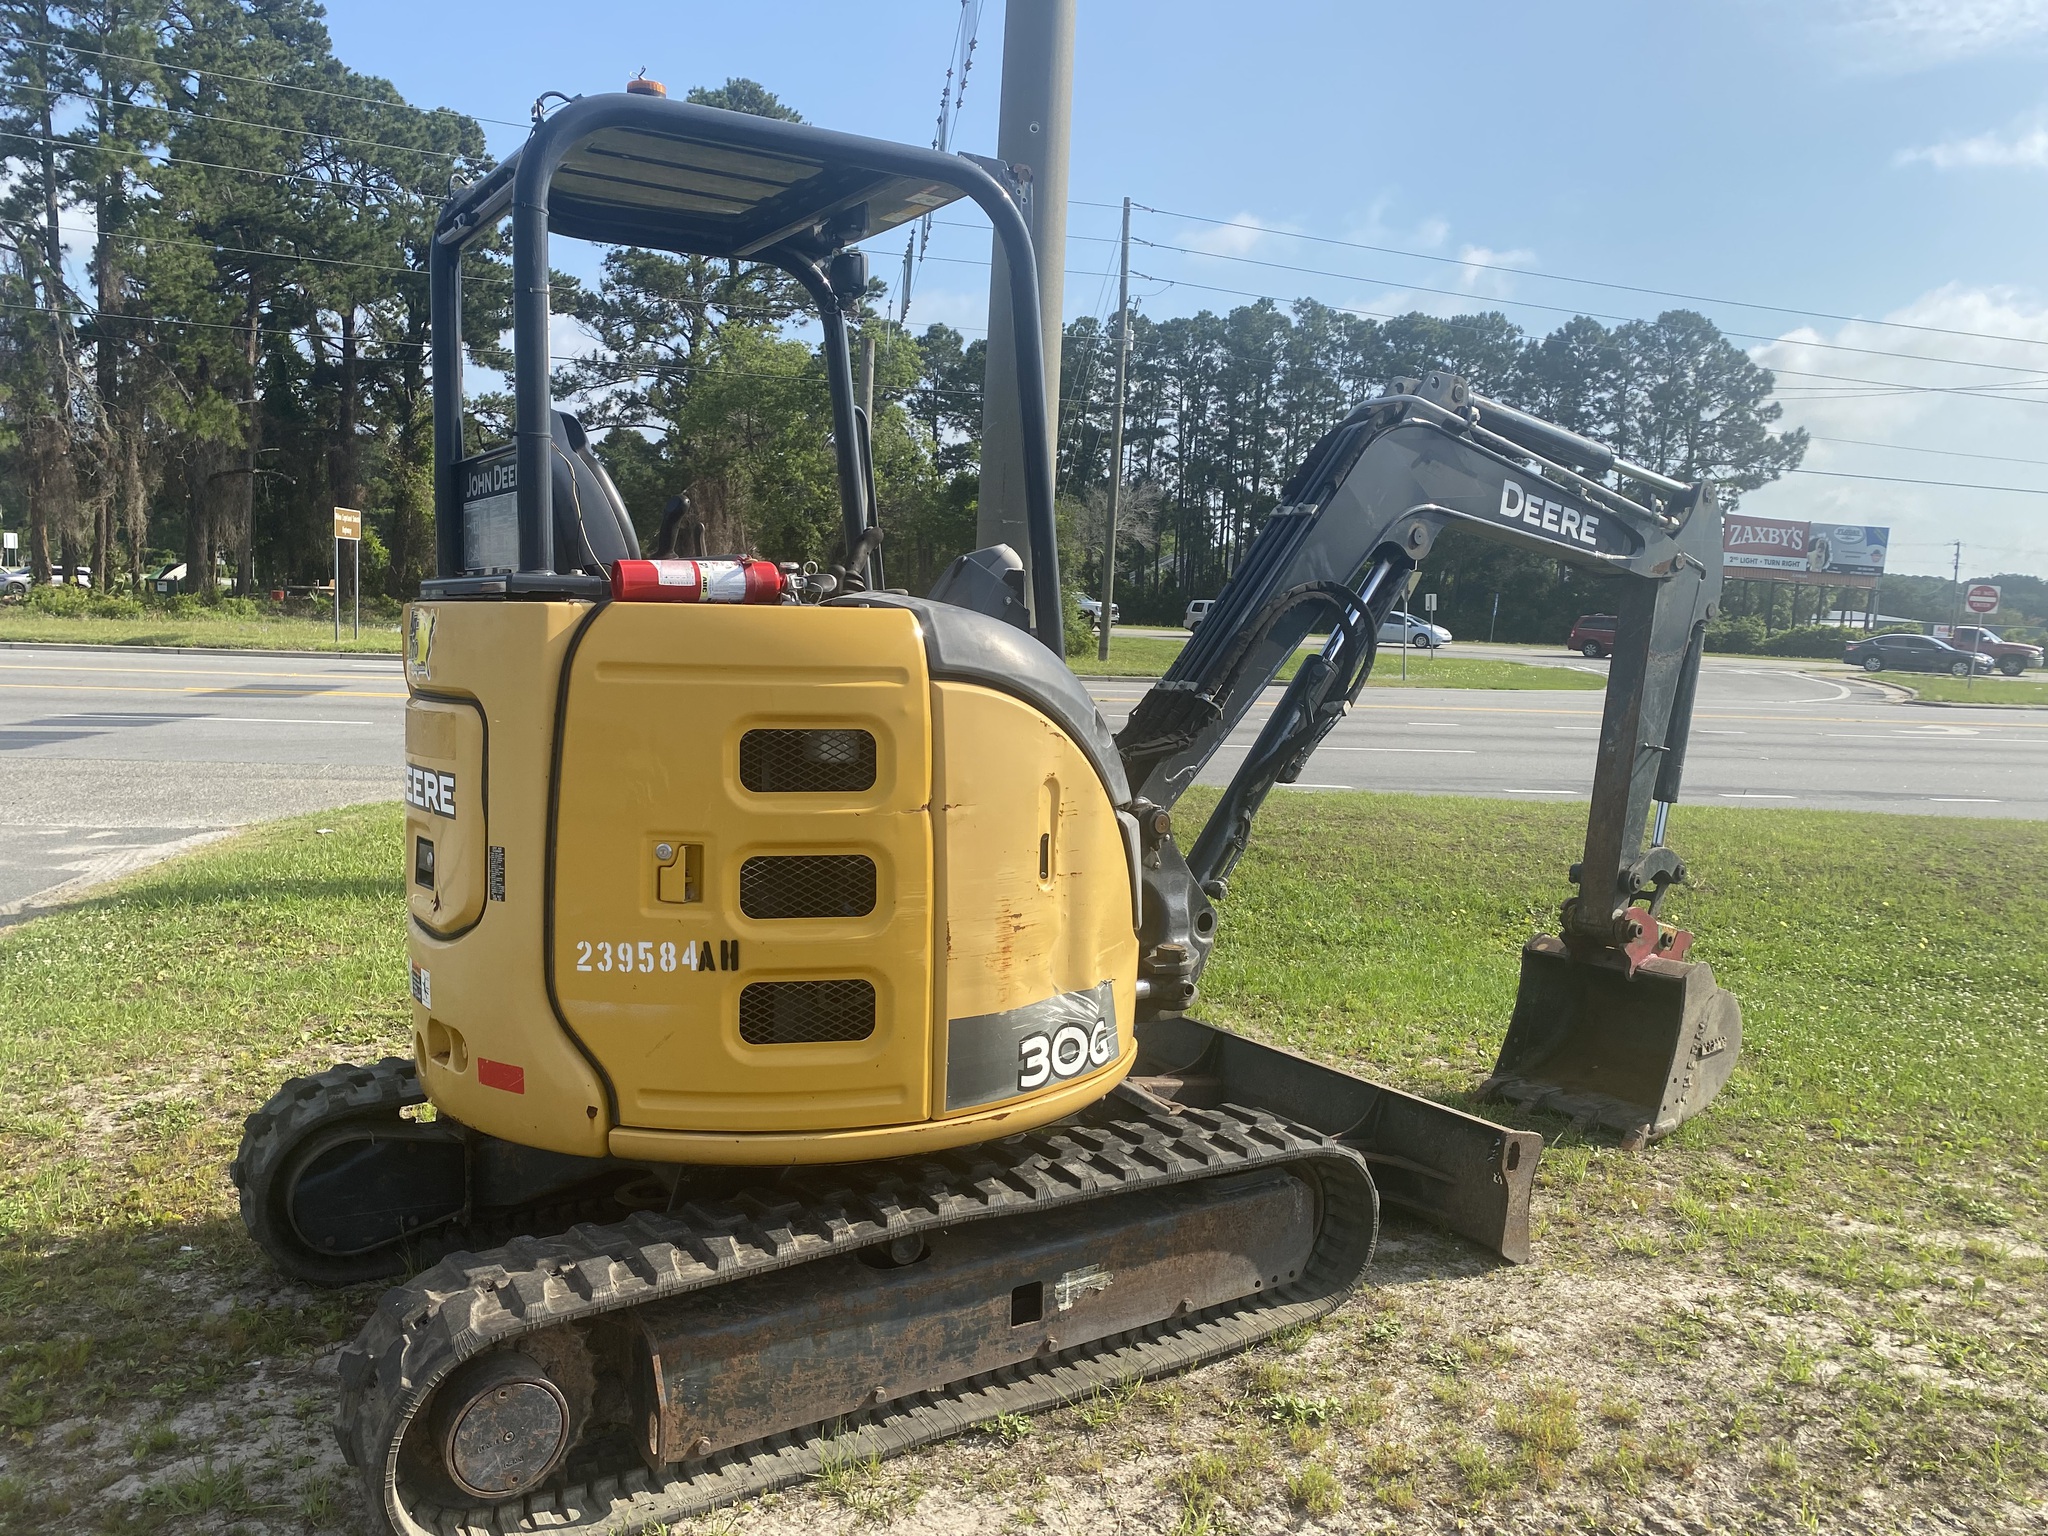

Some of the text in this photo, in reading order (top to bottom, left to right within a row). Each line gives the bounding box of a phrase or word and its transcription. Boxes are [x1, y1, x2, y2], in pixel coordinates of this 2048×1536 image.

[466, 471, 492, 498] JOHN
[1500, 478, 1600, 546] DEERE
[1728, 524, 1804, 551] ZAXBY'S
[1740, 557, 1758, 565] LIGHT
[1764, 558, 1780, 566] TURN
[1781, 560, 1800, 568] RIGHT
[1018, 1019, 1110, 1089] 30G
